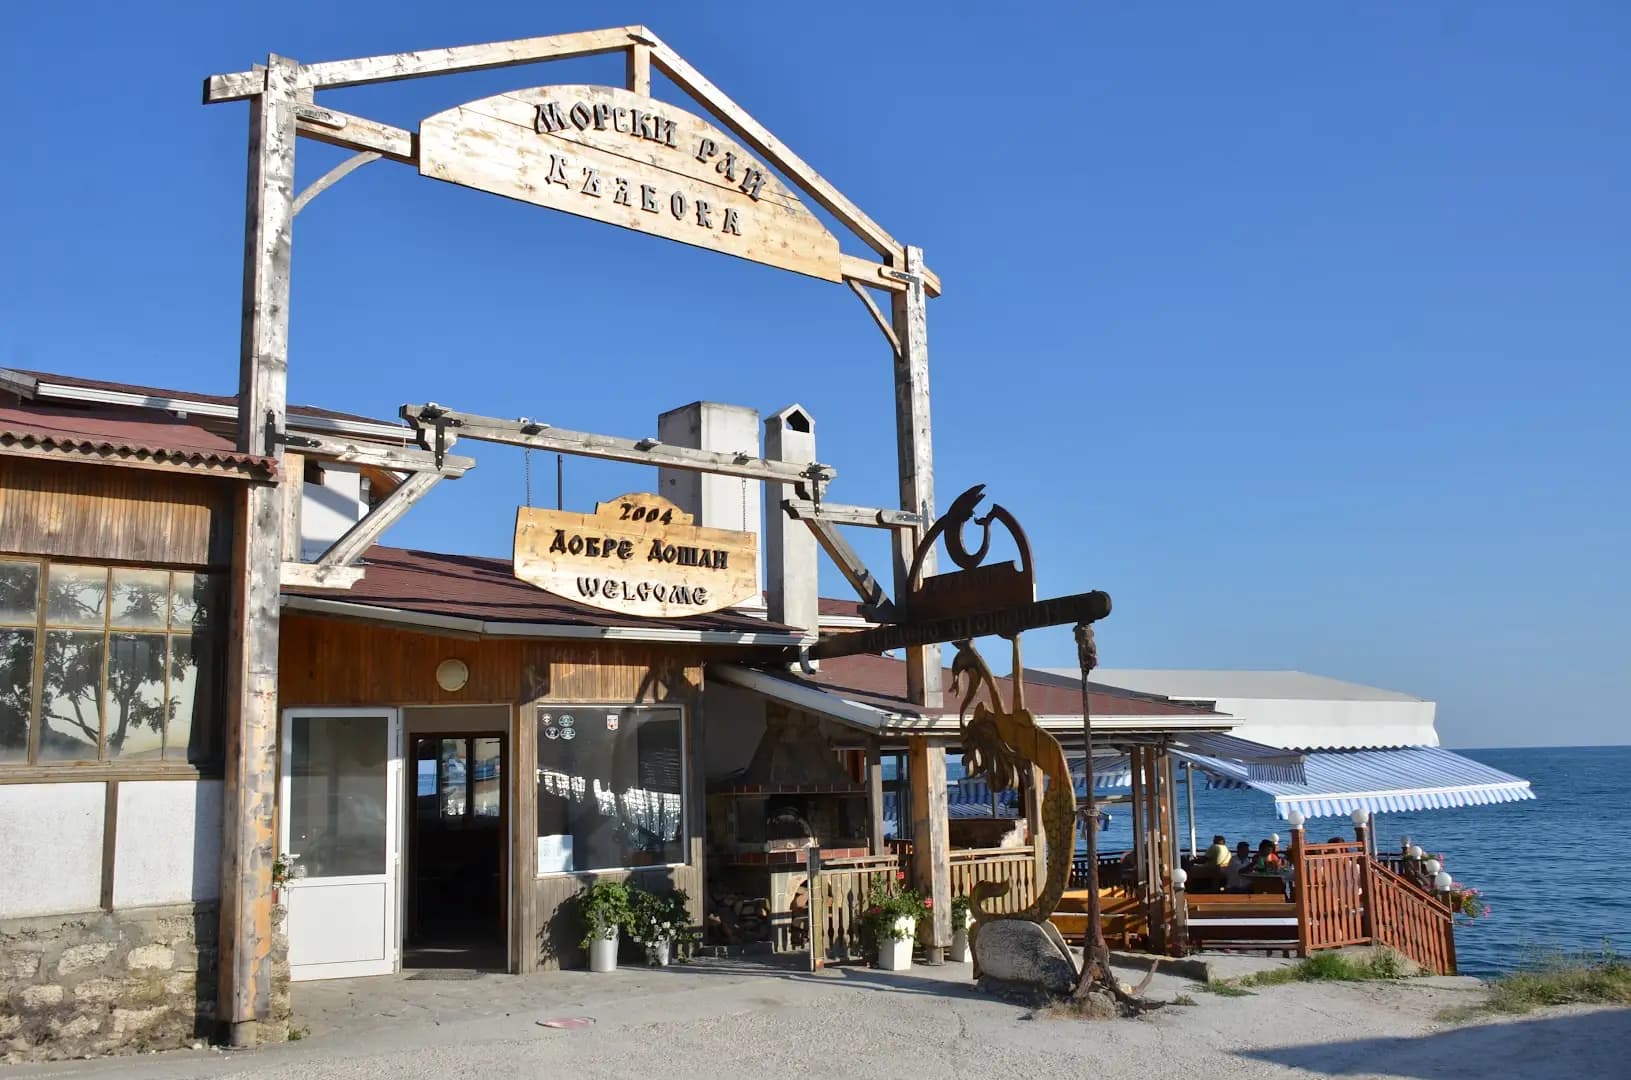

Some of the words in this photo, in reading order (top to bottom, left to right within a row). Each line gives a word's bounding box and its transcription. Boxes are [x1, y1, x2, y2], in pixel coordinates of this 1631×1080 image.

[534, 101, 678, 148] МОРСКИ
[619, 503, 673, 525] 2004
[549, 529, 634, 560] ДОБРЕ
[575, 576, 708, 606] WELCOME
